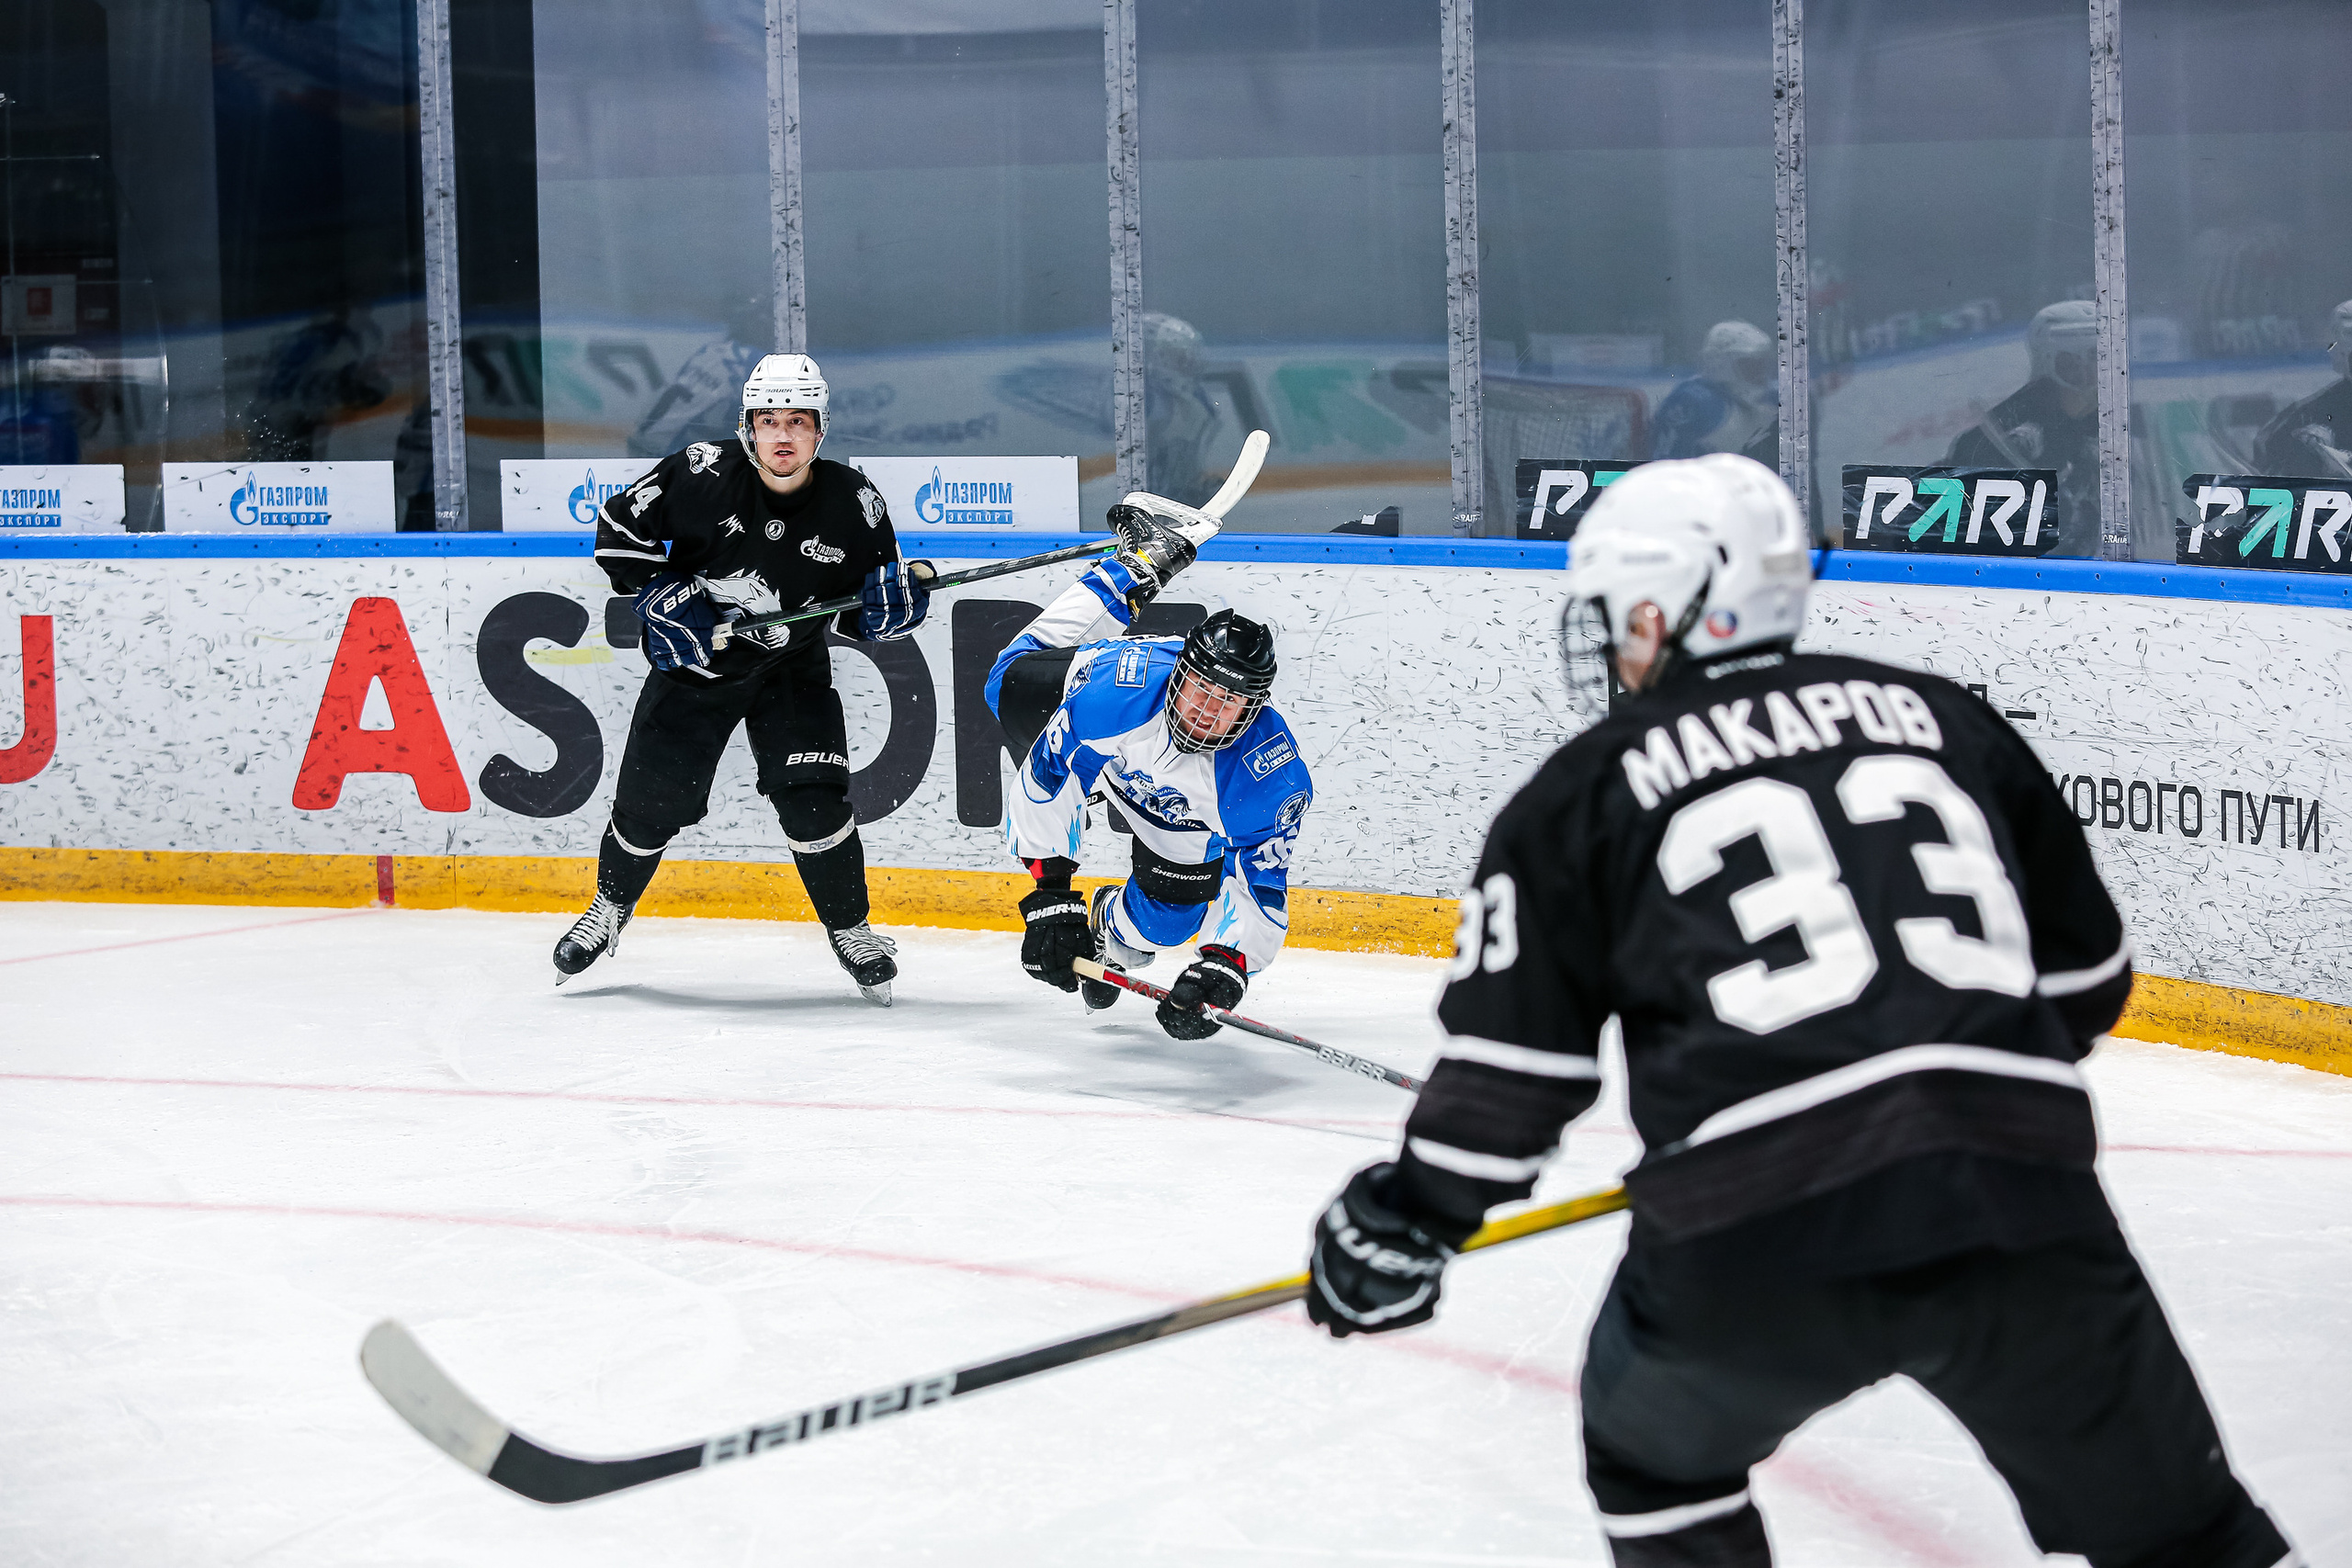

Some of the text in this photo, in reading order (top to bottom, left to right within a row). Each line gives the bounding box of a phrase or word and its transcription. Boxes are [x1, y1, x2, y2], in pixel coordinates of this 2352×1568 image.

[0, 489, 61, 508] АЗПРОМ
[260, 486, 328, 506] ГАЗПРОМ
[599, 484, 632, 504] ГАЗ
[945, 482, 1012, 504] ГАЗПРОМ
[263, 514, 327, 525] ЭКСПОРТ
[948, 512, 1011, 523] ЭКСПОРТ
[1856, 476, 2047, 547] PARI
[2188, 485, 2352, 563] PAR
[817, 543, 846, 559] ГАЗПРОМ
[662, 581, 701, 615] BAU
[1264, 740, 1290, 761] ГАЗПРОМ
[1621, 680, 1944, 810] МАКАРОВ
[786, 751, 850, 771] BAUER
[2220, 789, 2321, 852] ПУТИ
[1150, 866, 1213, 882] SHERWOOD
[1656, 753, 2038, 1035] 33
[699, 1371, 958, 1470] BAUER
